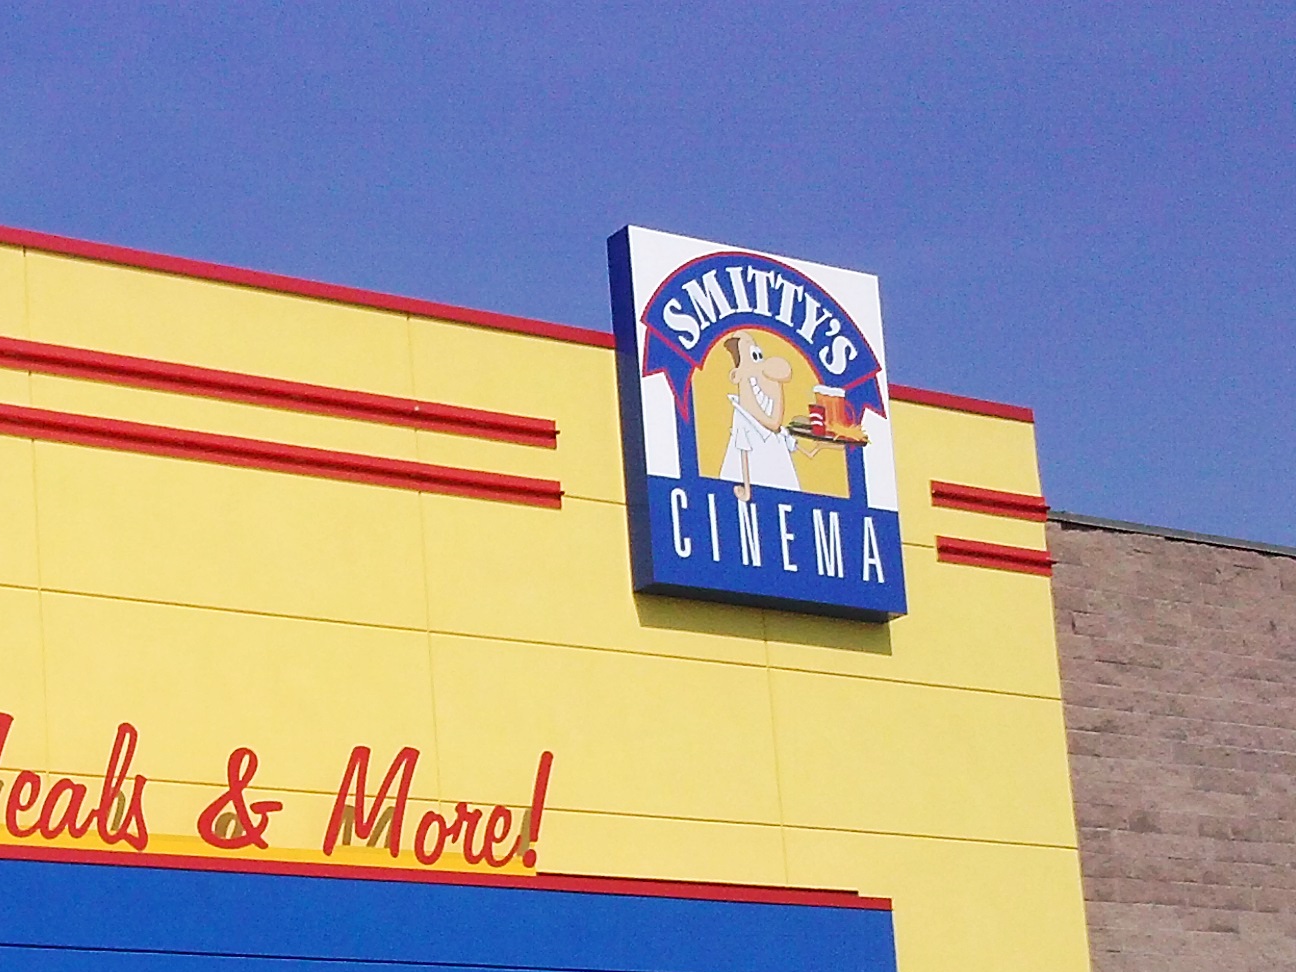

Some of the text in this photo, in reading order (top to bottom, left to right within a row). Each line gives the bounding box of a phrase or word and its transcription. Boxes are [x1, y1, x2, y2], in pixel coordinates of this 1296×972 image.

[662, 265, 859, 376] SMITTY'S
[670, 486, 885, 584] CINEMA
[197, 747, 283, 850] &
[323, 746, 554, 869] More!
